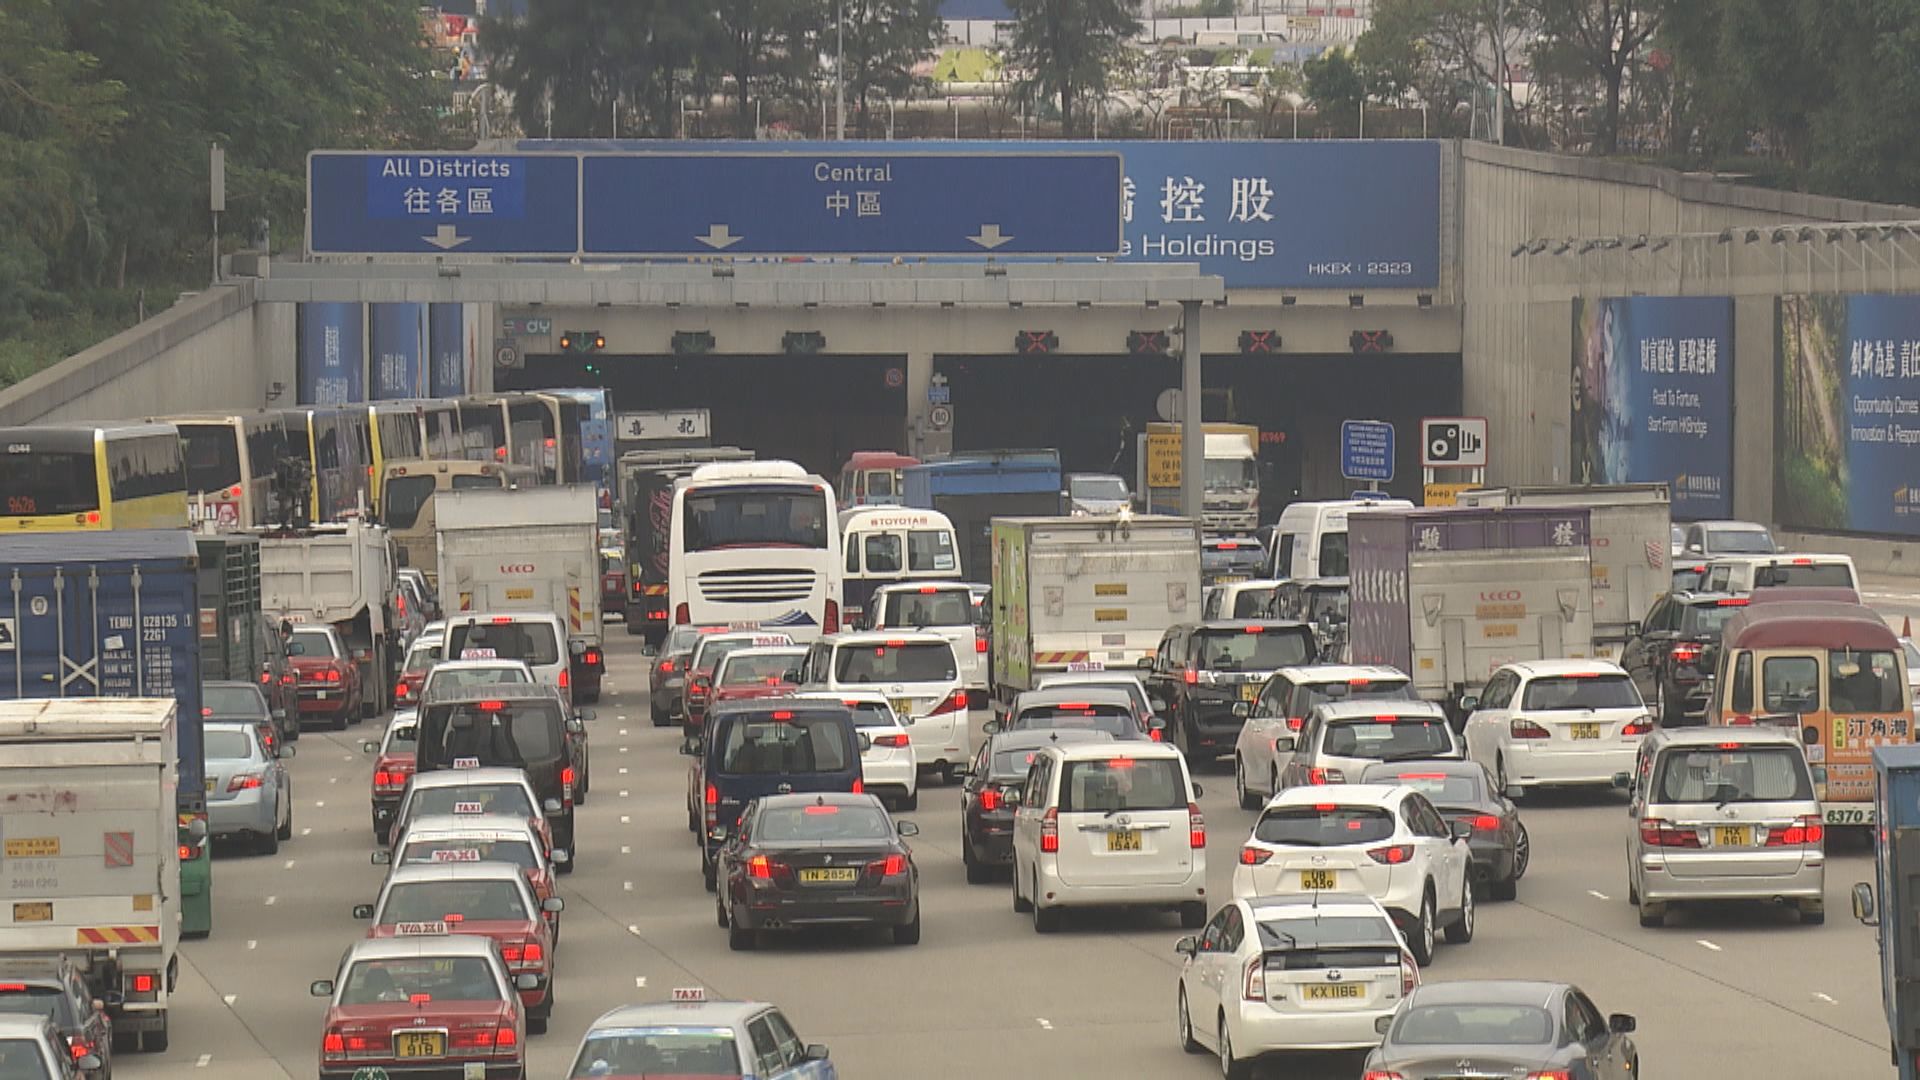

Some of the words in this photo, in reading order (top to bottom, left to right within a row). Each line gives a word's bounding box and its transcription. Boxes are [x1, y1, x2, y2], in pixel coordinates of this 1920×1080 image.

[383, 158, 411, 177] All
[419, 158, 510, 177] Districts
[815, 162, 893, 181] Central
[404, 187, 493, 213] 往各區
[826, 190, 881, 217] 中區
[1143, 234, 1275, 261] Holdings
[1309, 263, 1351, 273] HKEX
[1367, 262, 1411, 274] 2323
[1854, 395, 1893, 418] Opportunity
[1426, 488, 1450, 498] Keep
[880, 517, 918, 526] TOYOTA
[109, 616, 133, 629] TEMU
[755, 636, 784, 646] TAXI
[464, 649, 493, 658] TAXI
[456, 759, 477, 767] TAXI
[458, 803, 480, 811] TAXI
[1827, 810, 1863, 823] 6370
[436, 850, 476, 860] TAXI
[824, 870, 853, 880] 2854
[400, 924, 444, 934] TAXI
[675, 990, 702, 999] TAXI
[1311, 987, 1327, 998] KX
[1331, 986, 1358, 998] 1186
[410, 1034, 431, 1045] PE
